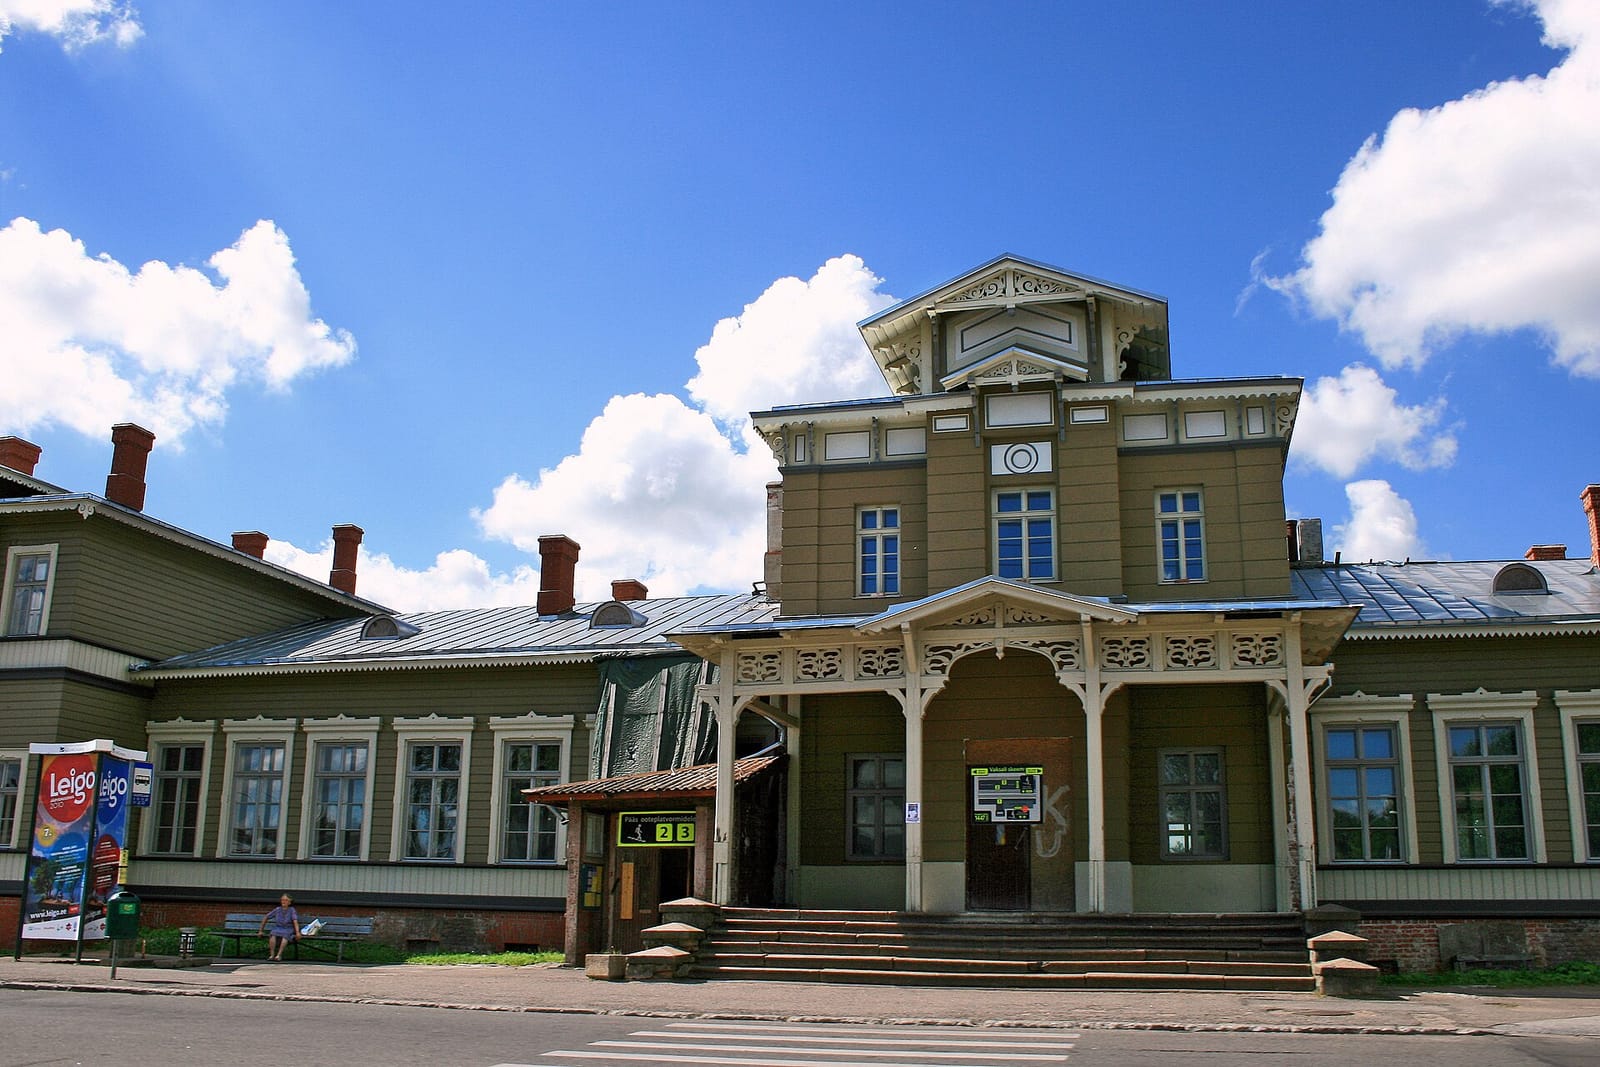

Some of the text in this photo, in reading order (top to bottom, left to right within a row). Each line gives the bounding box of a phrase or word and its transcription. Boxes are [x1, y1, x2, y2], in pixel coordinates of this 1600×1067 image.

[50, 768, 95, 804] Leigo
[660, 826, 690, 838] 2 3
